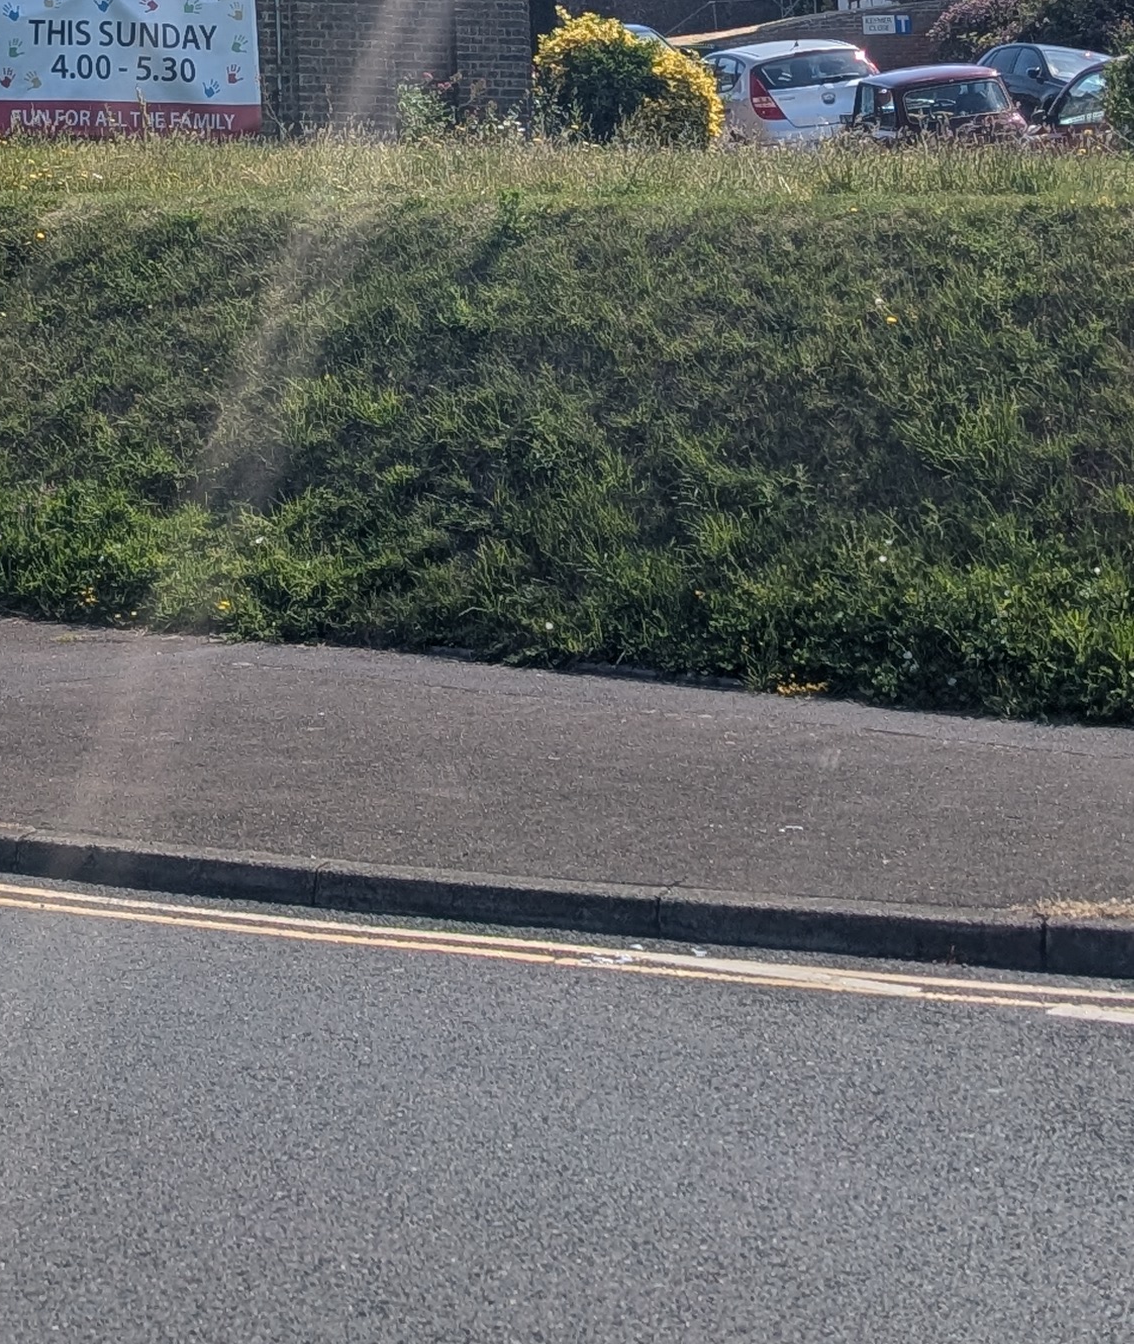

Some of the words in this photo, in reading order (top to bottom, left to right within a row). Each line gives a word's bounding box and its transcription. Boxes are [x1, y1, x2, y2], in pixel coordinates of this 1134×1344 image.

[29, 19, 91, 46] THIS
[99, 20, 217, 50] SUNDAY
[51, 54, 111, 80] 4.00
[136, 56, 196, 83] 5.30
[11, 109, 50, 126] FUN
[54, 109, 91, 126] FOR
[95, 111, 127, 127] ALL
[170, 112, 236, 130] FAMILY
